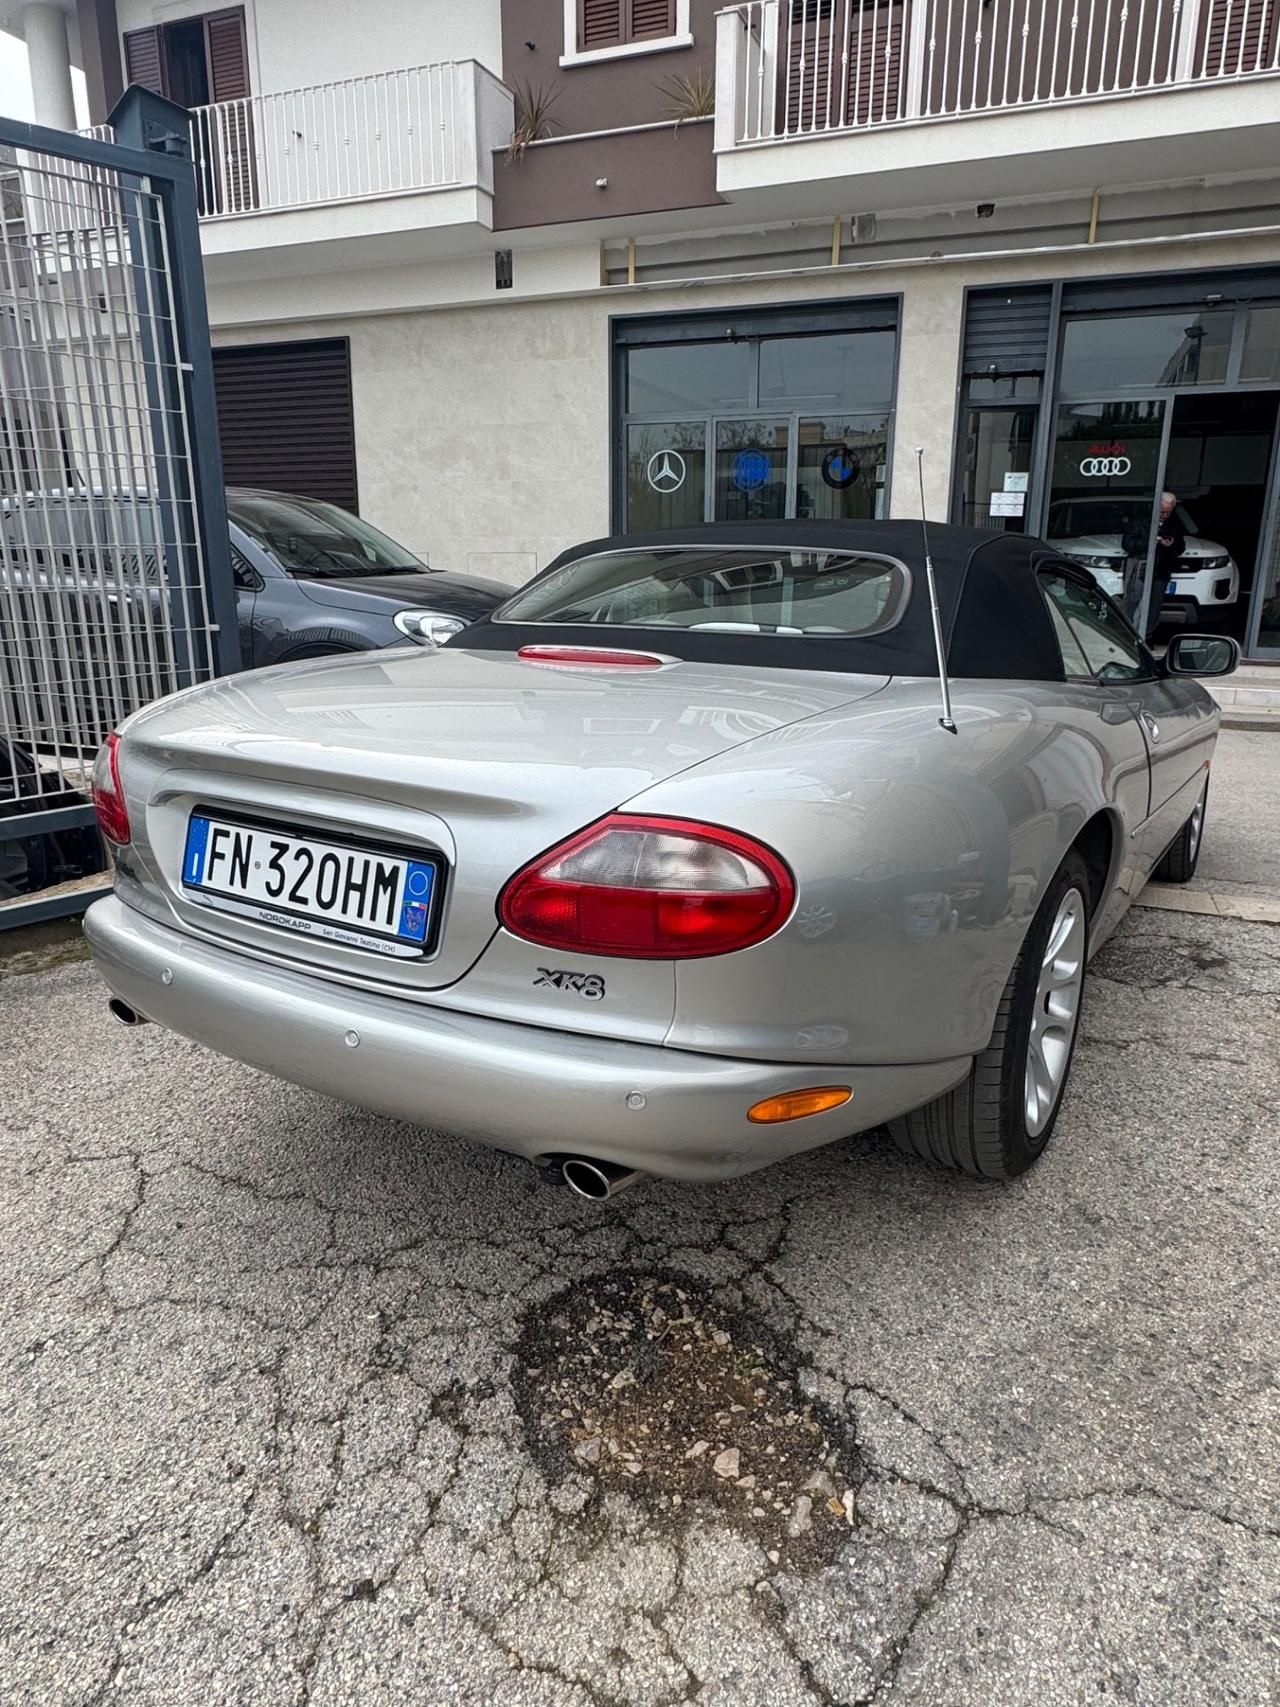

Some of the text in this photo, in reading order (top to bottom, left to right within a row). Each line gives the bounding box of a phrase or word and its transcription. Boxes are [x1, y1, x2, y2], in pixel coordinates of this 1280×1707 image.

[207, 828, 400, 926] FN 320HM
[259, 911, 311, 930] NORDKAPP
[322, 928, 333, 936] San
[334, 931, 358, 943] Giovanni
[533, 967, 605, 1000] XK8
